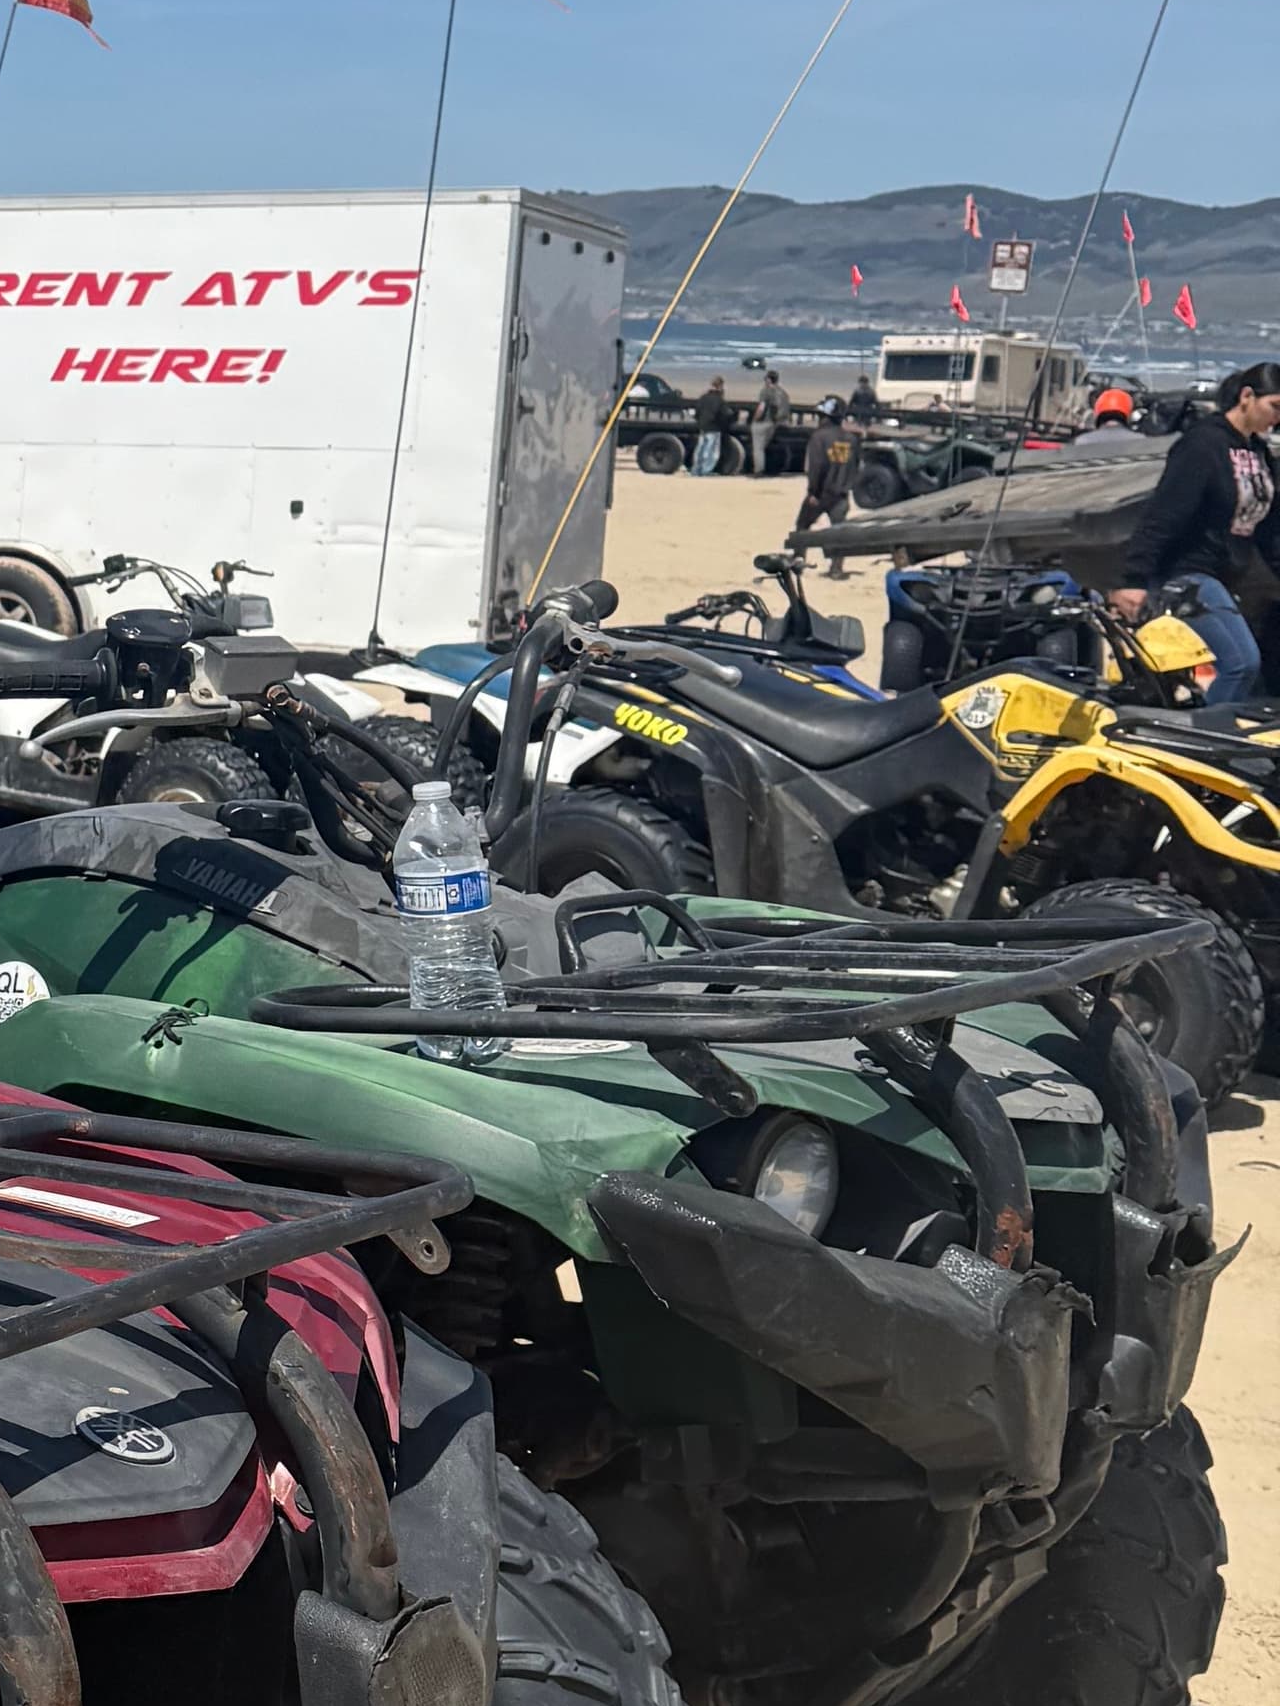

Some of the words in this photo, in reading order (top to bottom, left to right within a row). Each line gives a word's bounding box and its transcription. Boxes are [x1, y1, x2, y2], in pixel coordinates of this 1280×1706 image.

[181, 270, 424, 306] ATV'S
[50, 348, 288, 384] HERE!
[614, 702, 689, 746] YOKO
